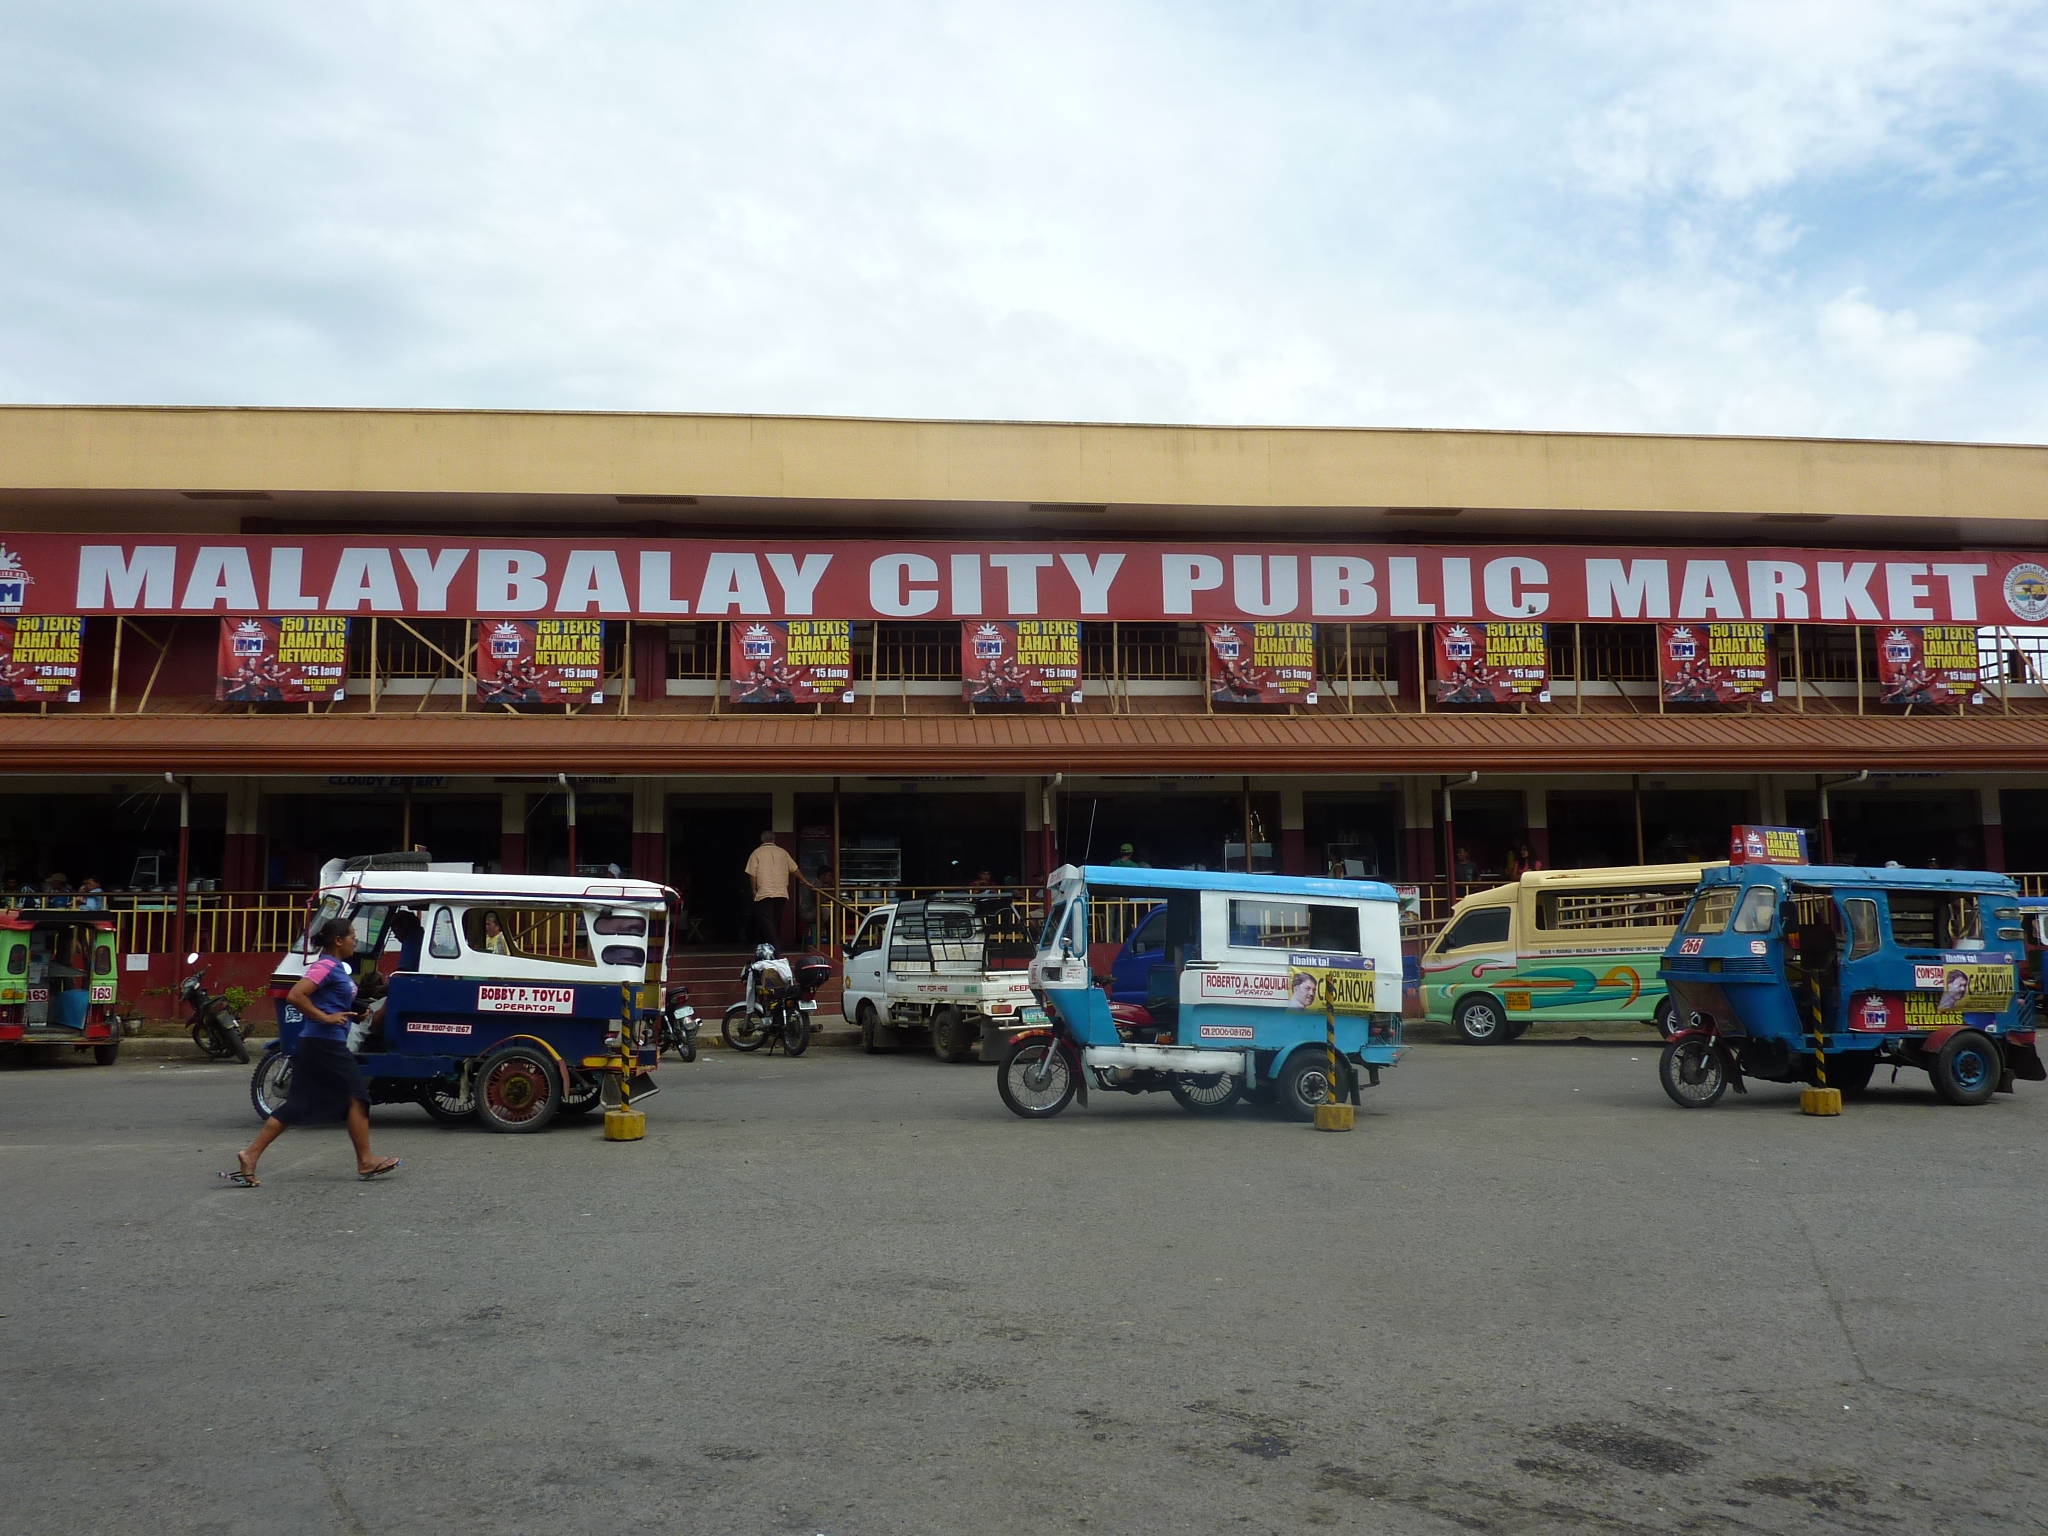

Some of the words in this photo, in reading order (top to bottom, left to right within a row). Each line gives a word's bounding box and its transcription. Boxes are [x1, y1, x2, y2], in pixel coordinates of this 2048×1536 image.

[77, 546, 833, 617] MALAYBALAY
[870, 554, 1126, 617] CITY
[1162, 554, 1549, 619] PUBLIC
[1586, 559, 1988, 621] MARKET
[16, 617, 41, 631] 150
[42, 617, 81, 631] TEXTS
[281, 617, 304, 631] 150
[308, 617, 346, 631] TEXTS
[536, 621, 560, 634] 150
[563, 621, 600, 634] TEXTS
[787, 621, 810, 635] 150
[812, 621, 849, 635] TEXTS
[1017, 621, 1039, 635] 150
[1042, 621, 1078, 635] TEXTS
[1253, 623, 1275, 637] 150
[1277, 623, 1313, 637] TEXTS
[1485, 623, 1506, 637] 150
[1508, 623, 1543, 637] TEXTS
[1708, 624, 1729, 637] 150
[1730, 624, 1765, 637] TEXTS
[14, 632, 59, 648] LAHAT
[60, 632, 80, 648] NG
[1922, 627, 1941, 640] 150
[1943, 627, 1975, 640] TEXTS
[237, 640, 260, 650] TM
[279, 633, 323, 648] LAHAT
[325, 633, 345, 648] NG
[494, 641, 517, 653] TM
[536, 635, 580, 651] LAHAT
[581, 635, 600, 651] NG
[788, 636, 829, 651] LAHAT
[831, 636, 850, 651] NG
[1017, 636, 1058, 651] LAHAT
[1060, 636, 1078, 651] NG
[1254, 638, 1294, 653] LAHAT
[1296, 638, 1313, 653] NG
[1486, 638, 1525, 653] LAHAT
[1527, 638, 1544, 653] NG
[1709, 638, 1746, 653] LAHAT
[1748, 638, 1765, 653] NG
[746, 643, 770, 654] TM
[977, 642, 1000, 653] TM
[1216, 643, 1237, 654] TM
[1449, 644, 1470, 655] TM
[1672, 645, 1693, 655] TM
[1889, 647, 1910, 657] TM
[1923, 641, 1958, 655] LAHAT
[1960, 641, 1977, 655] NG
[12, 649, 79, 663] NETWORKS
[278, 649, 344, 663] NETWORKS
[535, 651, 599, 665] NETWORKS
[788, 652, 849, 665] NETWORKS
[1017, 652, 1079, 665] NETWORKS
[1254, 653, 1313, 667] NETWORKS
[1486, 653, 1545, 667] NETWORKS
[1709, 653, 1766, 667] NETWORKS
[1924, 656, 1977, 669] NETWORKS
[54, 666, 76, 677] lang
[321, 666, 342, 676] lang
[577, 668, 598, 679] lang
[828, 668, 849, 678] lang
[1057, 668, 1077, 678] lang
[1293, 669, 1312, 680] lang
[1525, 669, 1545, 679] lang
[1747, 669, 1766, 679] lang
[1959, 671, 1977, 681] lang
[329, 776, 384, 786] CLOUDY
[1765, 831, 1778, 840] 150
[1778, 831, 1798, 841] TEXTS
[1766, 840, 1787, 849] LAHAT
[1788, 841, 1799, 850] NG
[1767, 848, 1800, 858] NETWORKS
[1680, 940, 1700, 953] 266
[1008, 984, 1030, 993] KEEP
[1206, 975, 1242, 989] ROBERTO
[1968, 974, 2014, 996] CASANOVA
[28, 990, 48, 1000] 163
[92, 987, 112, 1000] 163
[481, 988, 516, 1001] BOBBY
[518, 989, 528, 1001] P.
[532, 990, 572, 1003] TOYLO
[1235, 988, 1273, 997] OPERATOR
[1318, 977, 1375, 1004] CSANOVA
[495, 1003, 556, 1012] OPERATOR
[1904, 1002, 1936, 1015] LAHA
[1866, 1012, 1885, 1024] TM
[1905, 1014, 1964, 1025] NETWORKS
